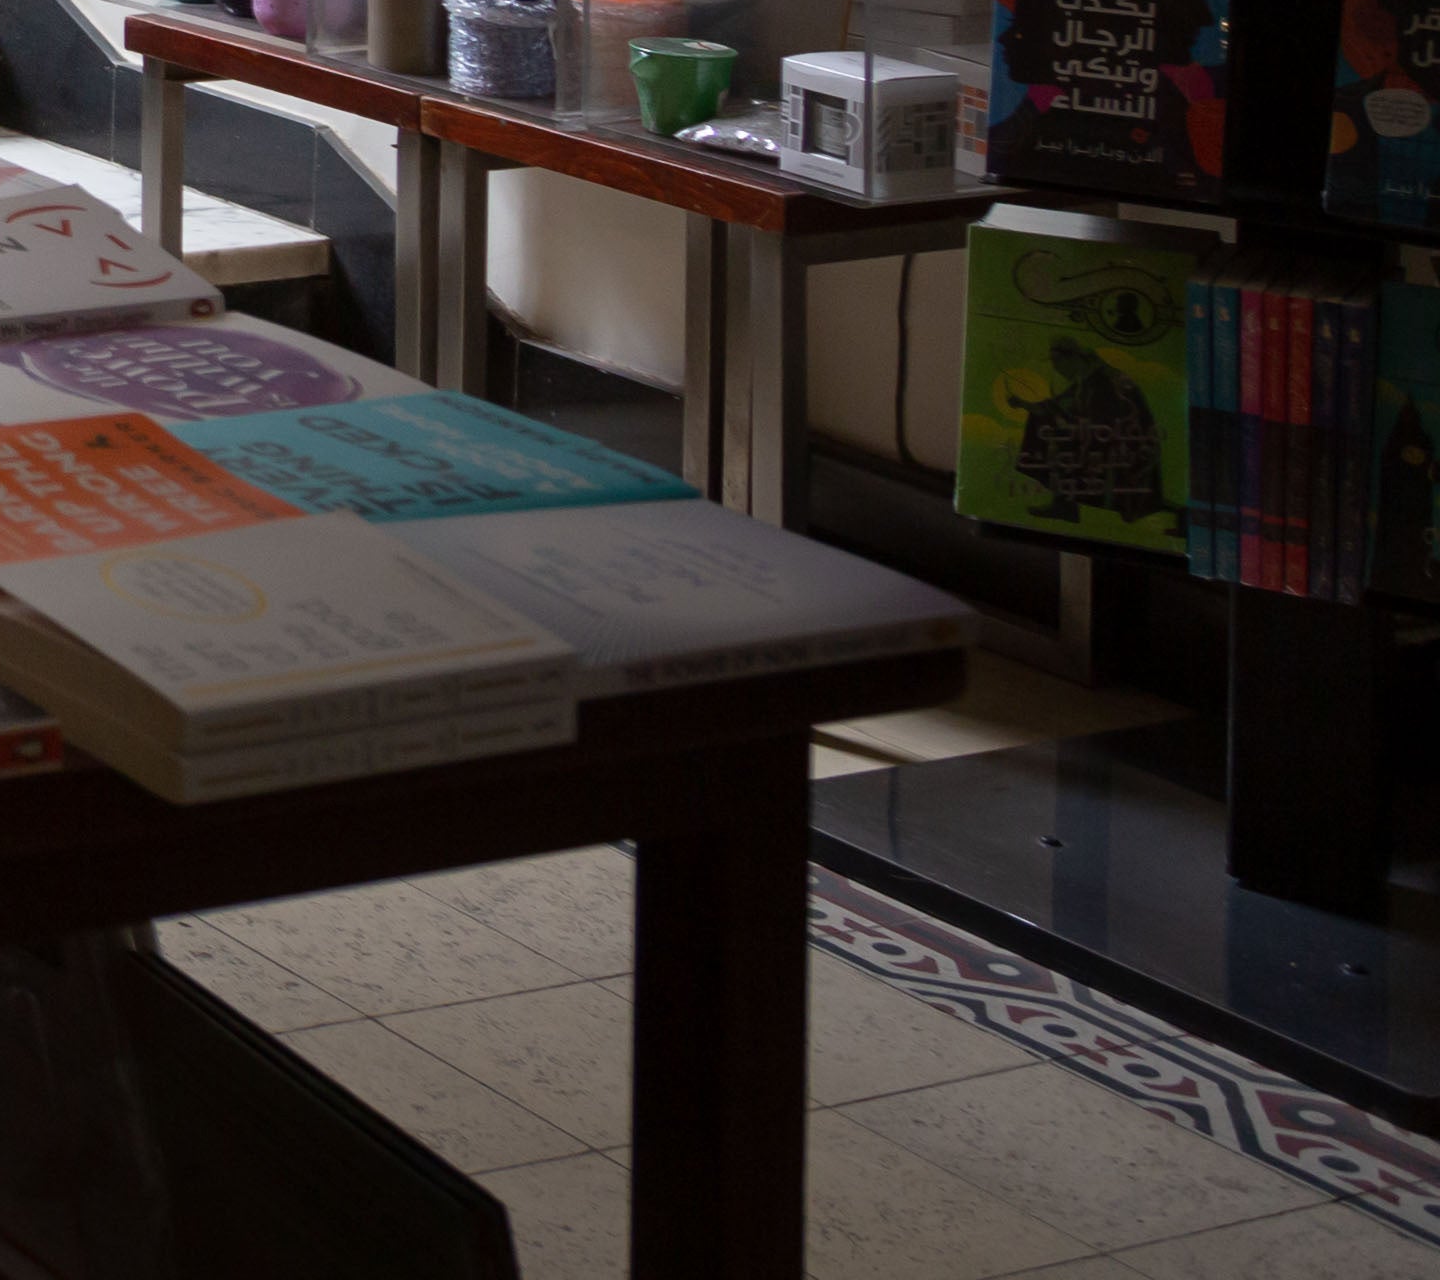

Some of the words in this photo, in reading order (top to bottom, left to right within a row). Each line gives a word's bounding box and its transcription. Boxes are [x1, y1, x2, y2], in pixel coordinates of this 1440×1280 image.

[1052, 19, 1155, 52] الرجال
[1053, 60, 1159, 93] وتبكي
[1050, 93, 1156, 120] النساء
[26, 430, 183, 531] WRONG
[241, 441, 419, 514] THING
[294, 415, 522, 501] FCKED
[58, 501, 127, 533] UP
[127, 464, 232, 526] TREE
